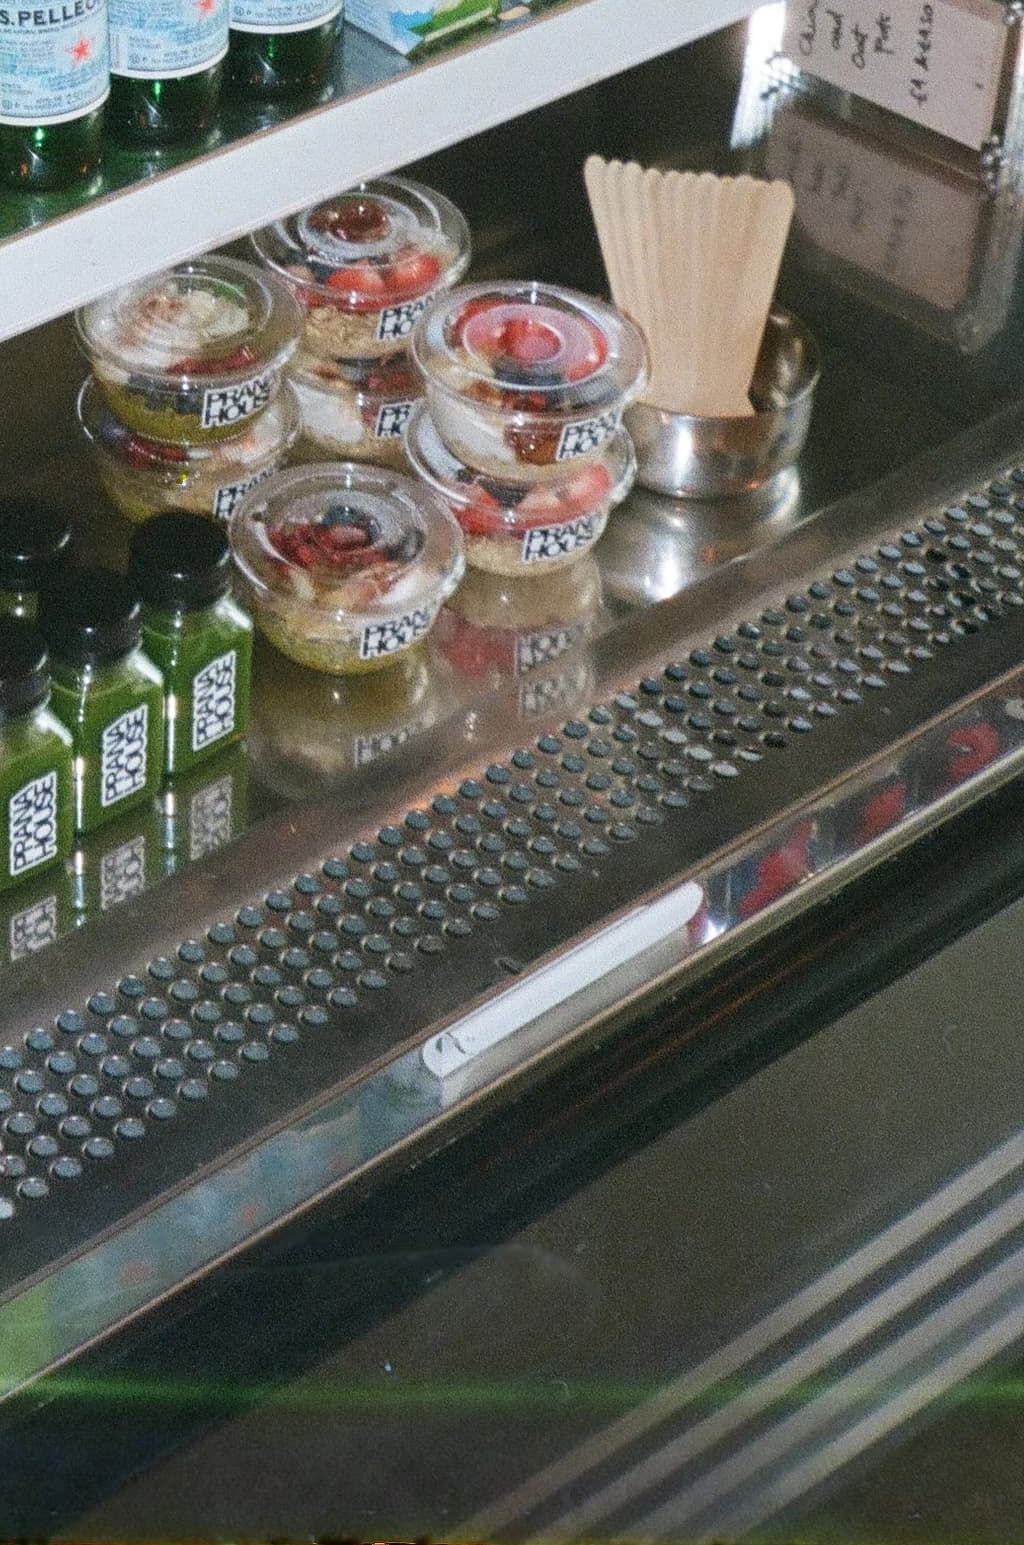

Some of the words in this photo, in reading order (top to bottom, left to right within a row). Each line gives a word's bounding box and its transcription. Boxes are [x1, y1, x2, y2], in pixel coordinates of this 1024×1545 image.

[196, 665, 216, 746] PRANA
[214, 653, 234, 736] HOUSE
[105, 717, 126, 803] PRANA
[125, 705, 146, 794] HOUSE
[12, 783, 34, 871] PRANA
[32, 774, 55, 863] HOUSE
